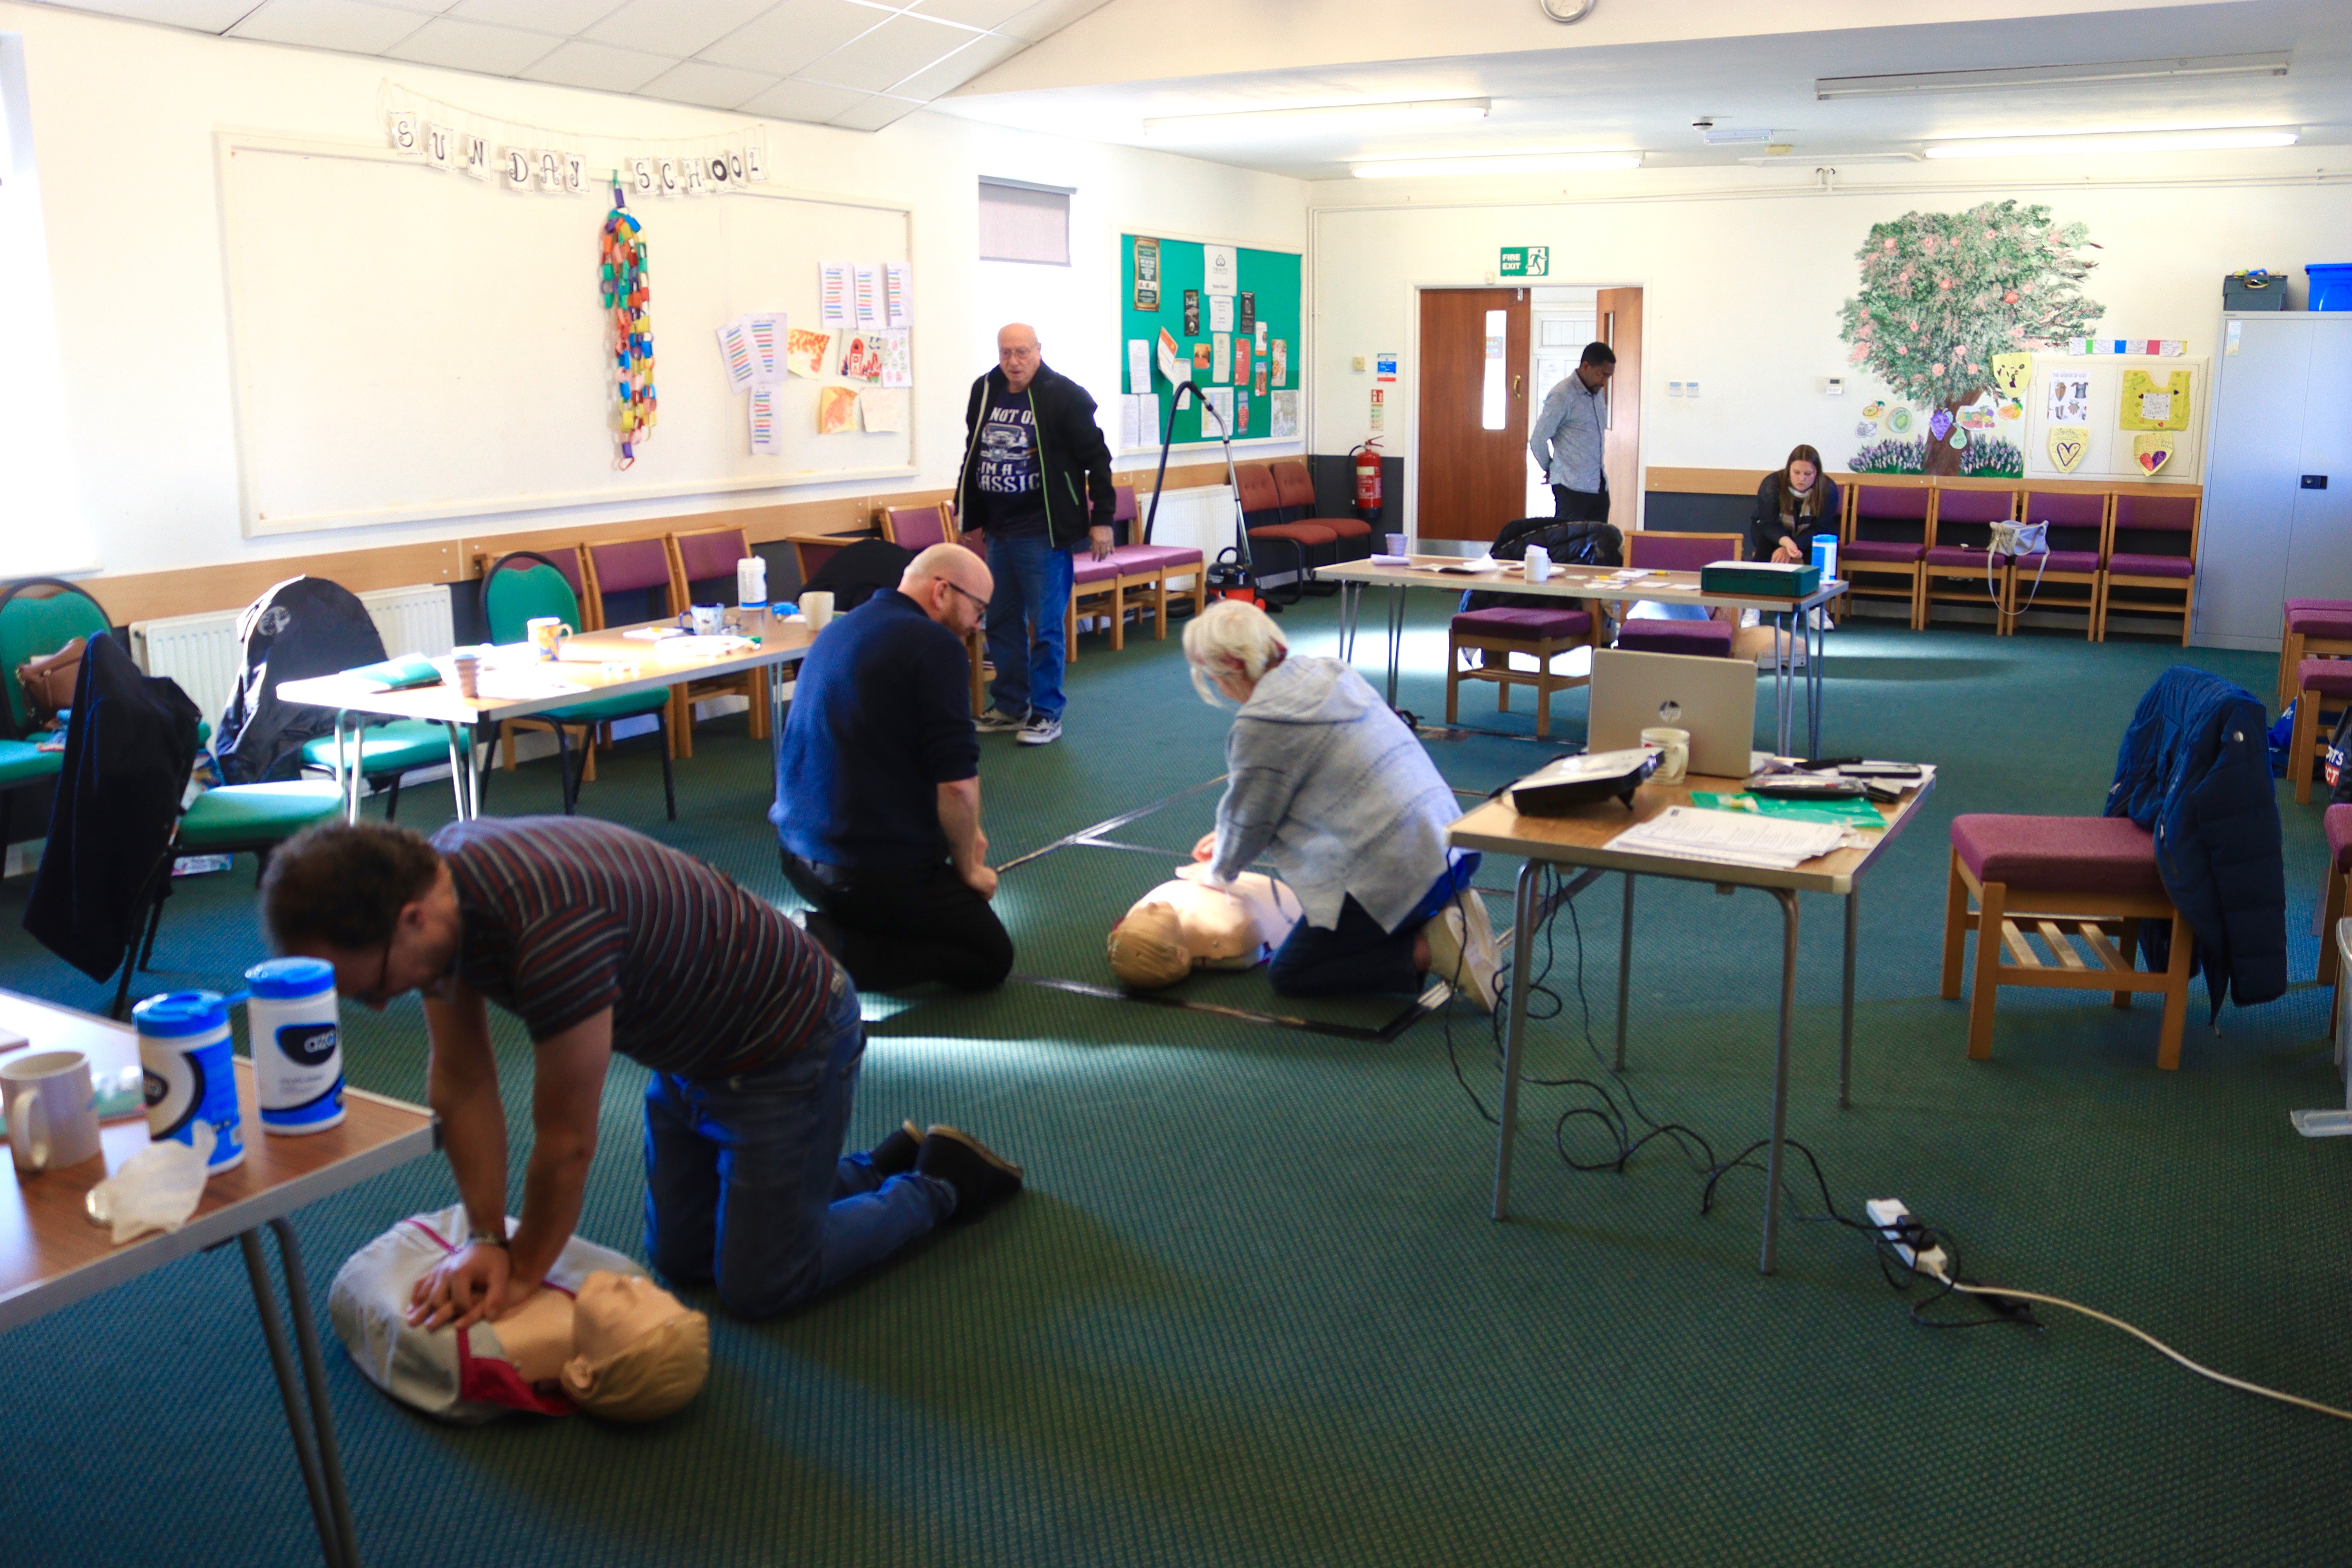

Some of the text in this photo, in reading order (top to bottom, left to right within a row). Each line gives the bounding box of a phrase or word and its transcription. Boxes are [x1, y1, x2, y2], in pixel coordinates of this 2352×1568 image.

[398, 120, 759, 189] SUNDAY SCHOOL
[989, 407, 1020, 423] NOT
[1001, 463, 1013, 475] A
